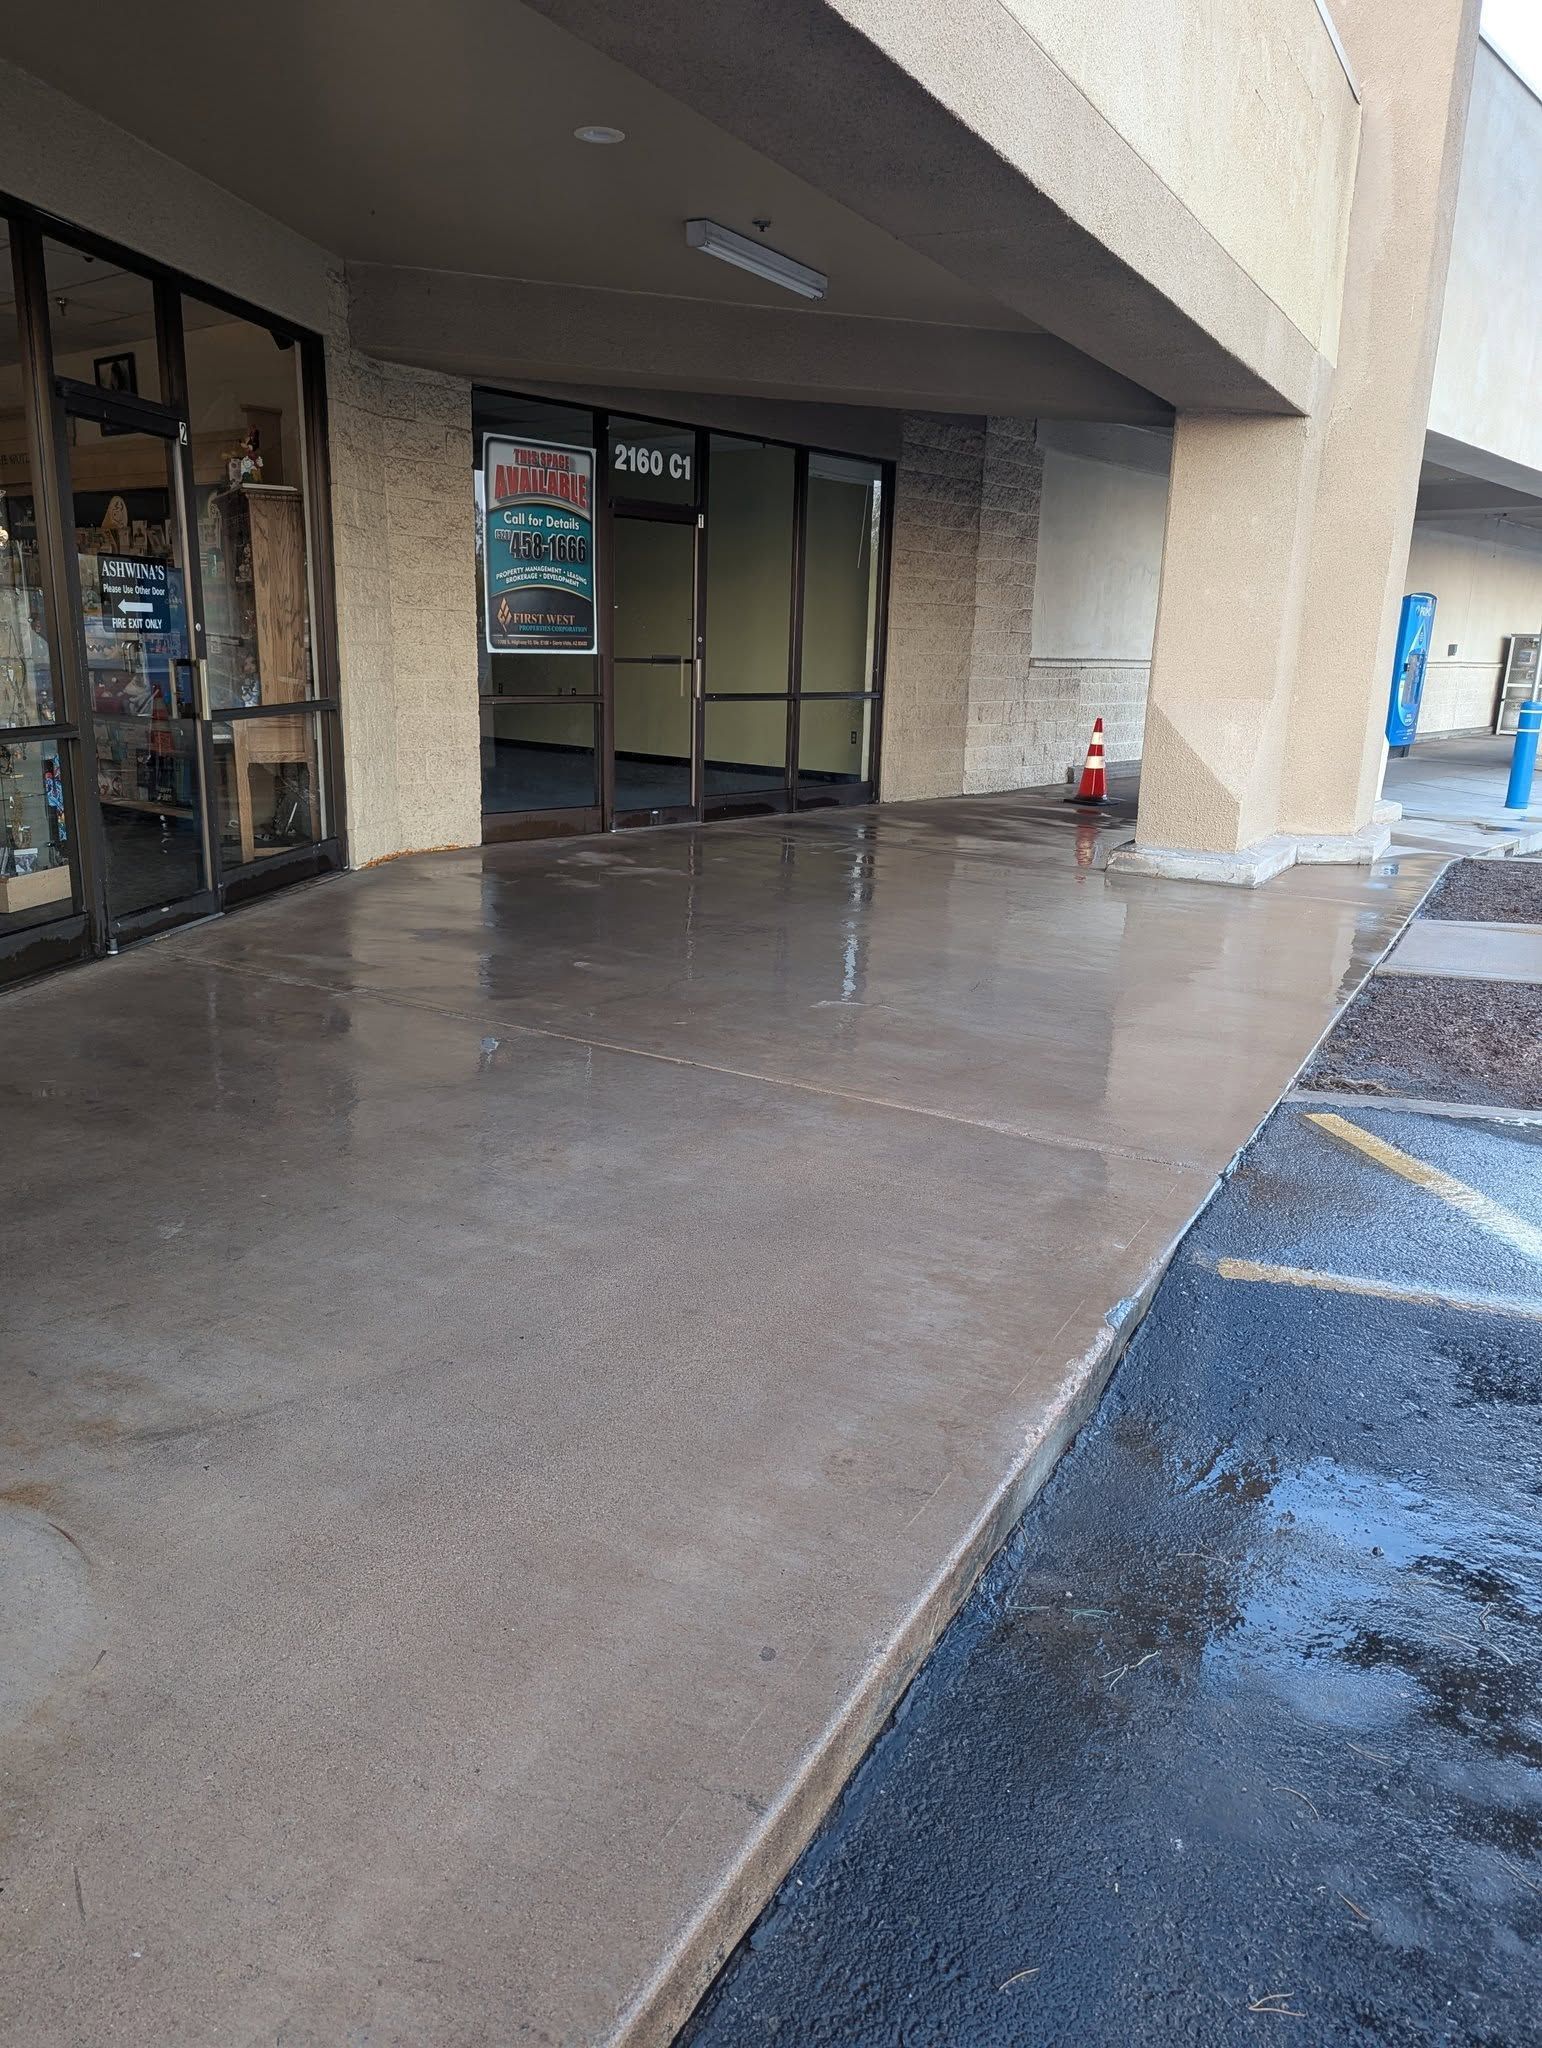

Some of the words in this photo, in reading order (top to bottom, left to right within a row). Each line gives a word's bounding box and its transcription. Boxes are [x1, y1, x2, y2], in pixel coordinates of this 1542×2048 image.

[513, 448, 539, 465] THIS
[540, 451, 570, 470] SPACE
[614, 444, 663, 476] 2160
[669, 453, 692, 481] C1
[494, 464, 588, 510] AVAILABLE
[503, 511, 526, 526] Call
[528, 513, 543, 528] for
[546, 515, 580, 531] Details
[509, 529, 587, 563] 458-1666
[101, 560, 165, 581] ASHWINA'S
[495, 567, 524, 580] PROPERTY
[525, 565, 562, 574] MANAGEMENT
[566, 570, 588, 585] LEASING
[505, 572, 538, 584] BROKERAGE
[543, 573, 580, 587] DEVELOPMENT
[103, 584, 121, 594] Please
[122, 584, 134, 595] Use
[135, 585, 151, 595] Other
[151, 586, 165, 596] Door
[112, 618, 127, 629] FIRE
[128, 618, 143, 629] EXIT
[145, 618, 163, 630] ONLY
[513, 613, 545, 625] FIRST
[546, 614, 576, 625] WEST
[519, 624, 551, 632] PROPERTIES
[551, 625, 588, 633] CORPORATION
